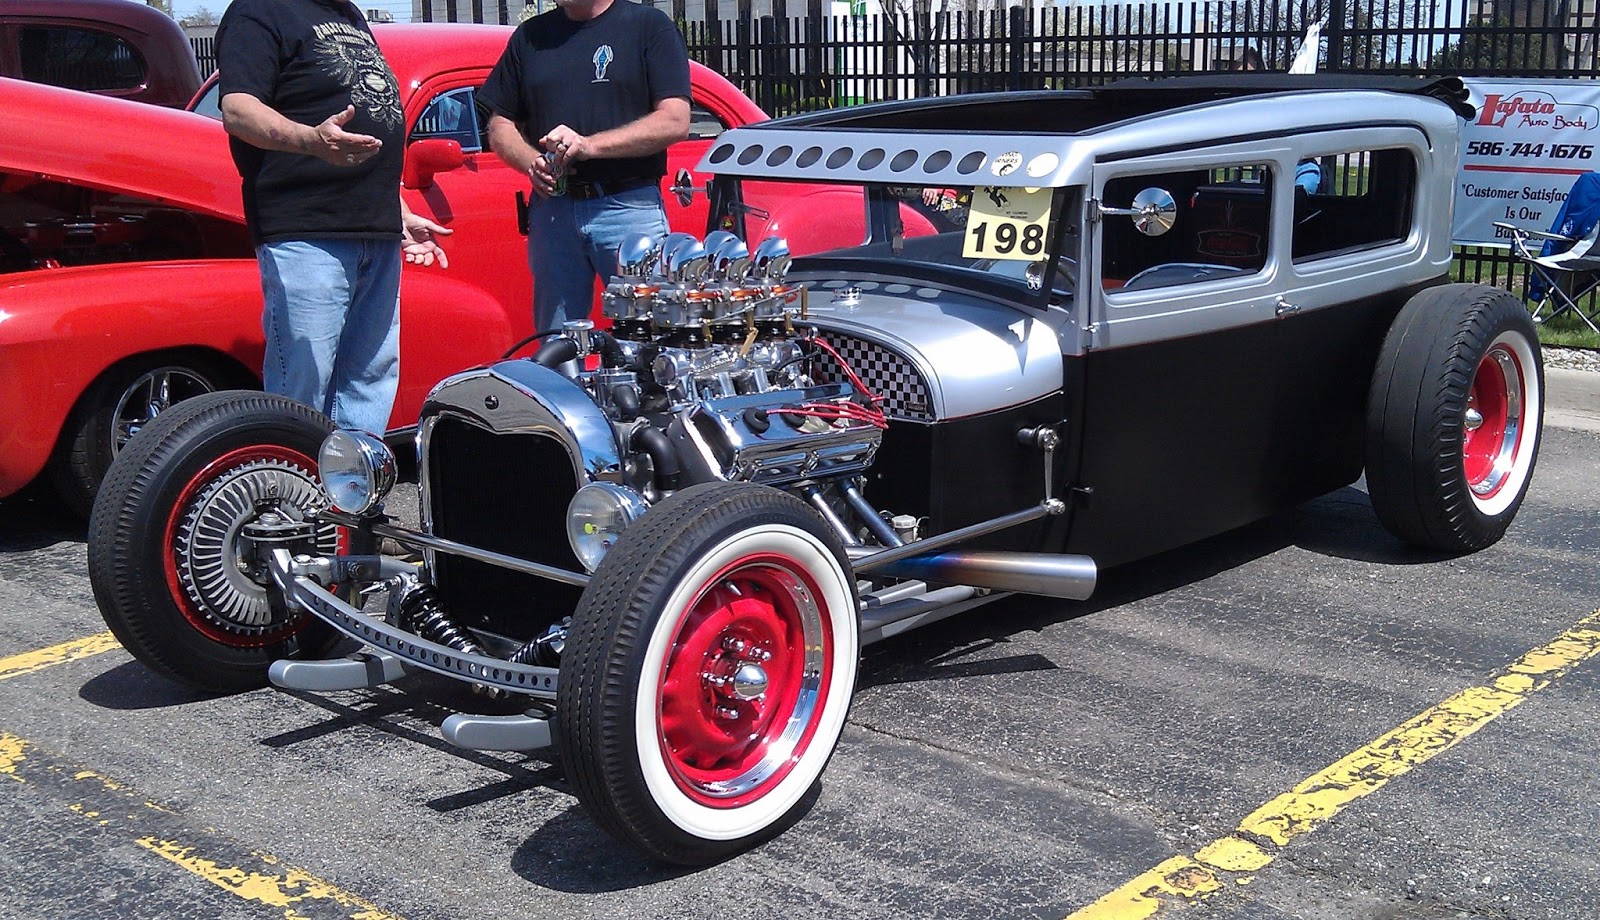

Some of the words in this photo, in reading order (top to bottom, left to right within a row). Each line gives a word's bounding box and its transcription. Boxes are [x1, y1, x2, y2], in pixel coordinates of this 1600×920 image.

[1475, 94, 1556, 128] Lafata
[1518, 115, 1549, 128] Auto
[1552, 115, 1587, 130] Body
[1462, 184, 1519, 199] "Customer
[1521, 187, 1569, 204] Satisfac
[1505, 206, 1516, 219] Is
[1519, 207, 1542, 220] Our
[972, 222, 1043, 255] 198
